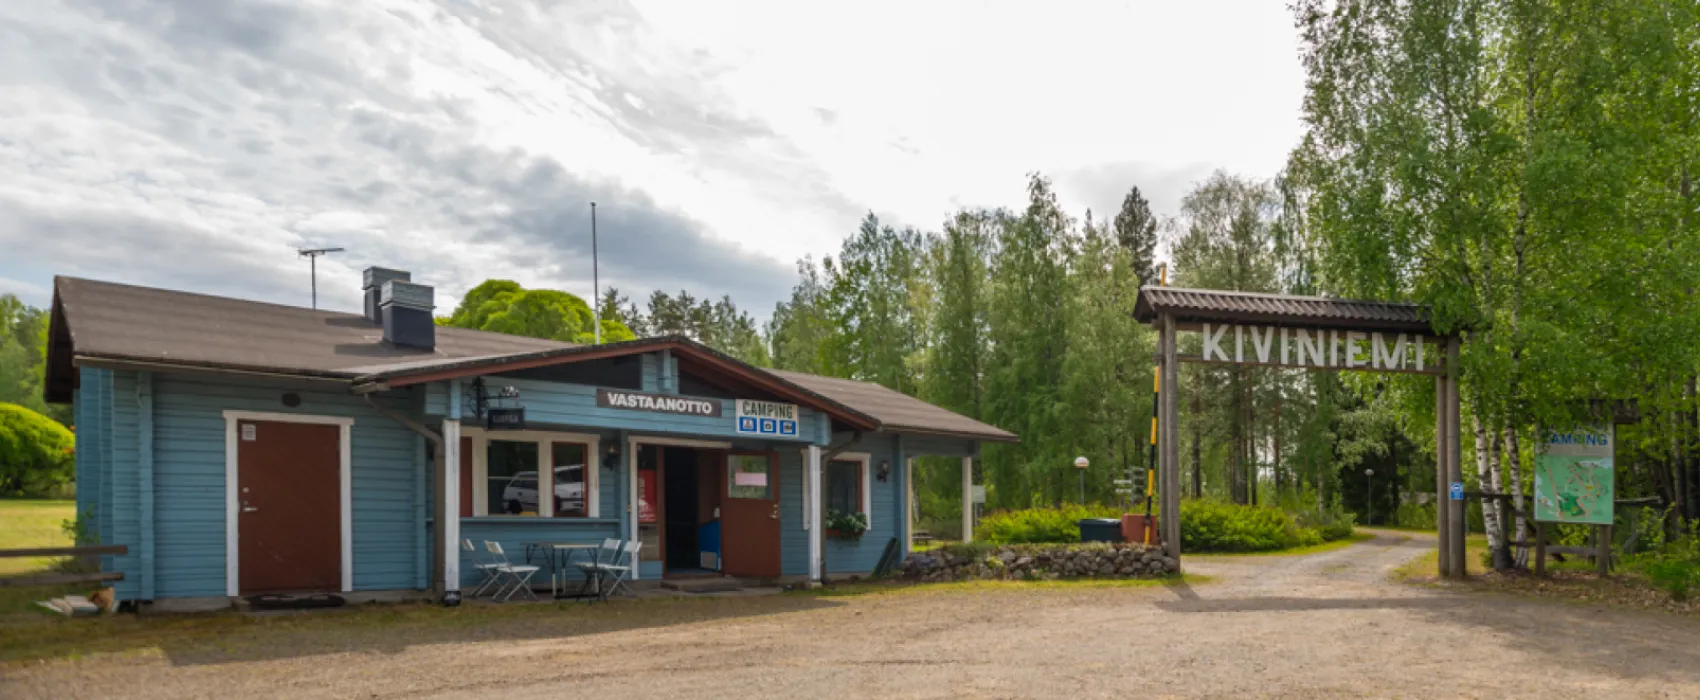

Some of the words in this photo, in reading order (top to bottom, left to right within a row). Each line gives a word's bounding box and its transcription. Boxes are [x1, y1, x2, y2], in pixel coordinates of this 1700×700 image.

[1202, 323, 1424, 371] KIVINIEMI
[607, 392, 712, 414] VASTAANOTTO
[743, 401, 793, 419] CAMPING
[1542, 432, 1608, 446] AMNG
